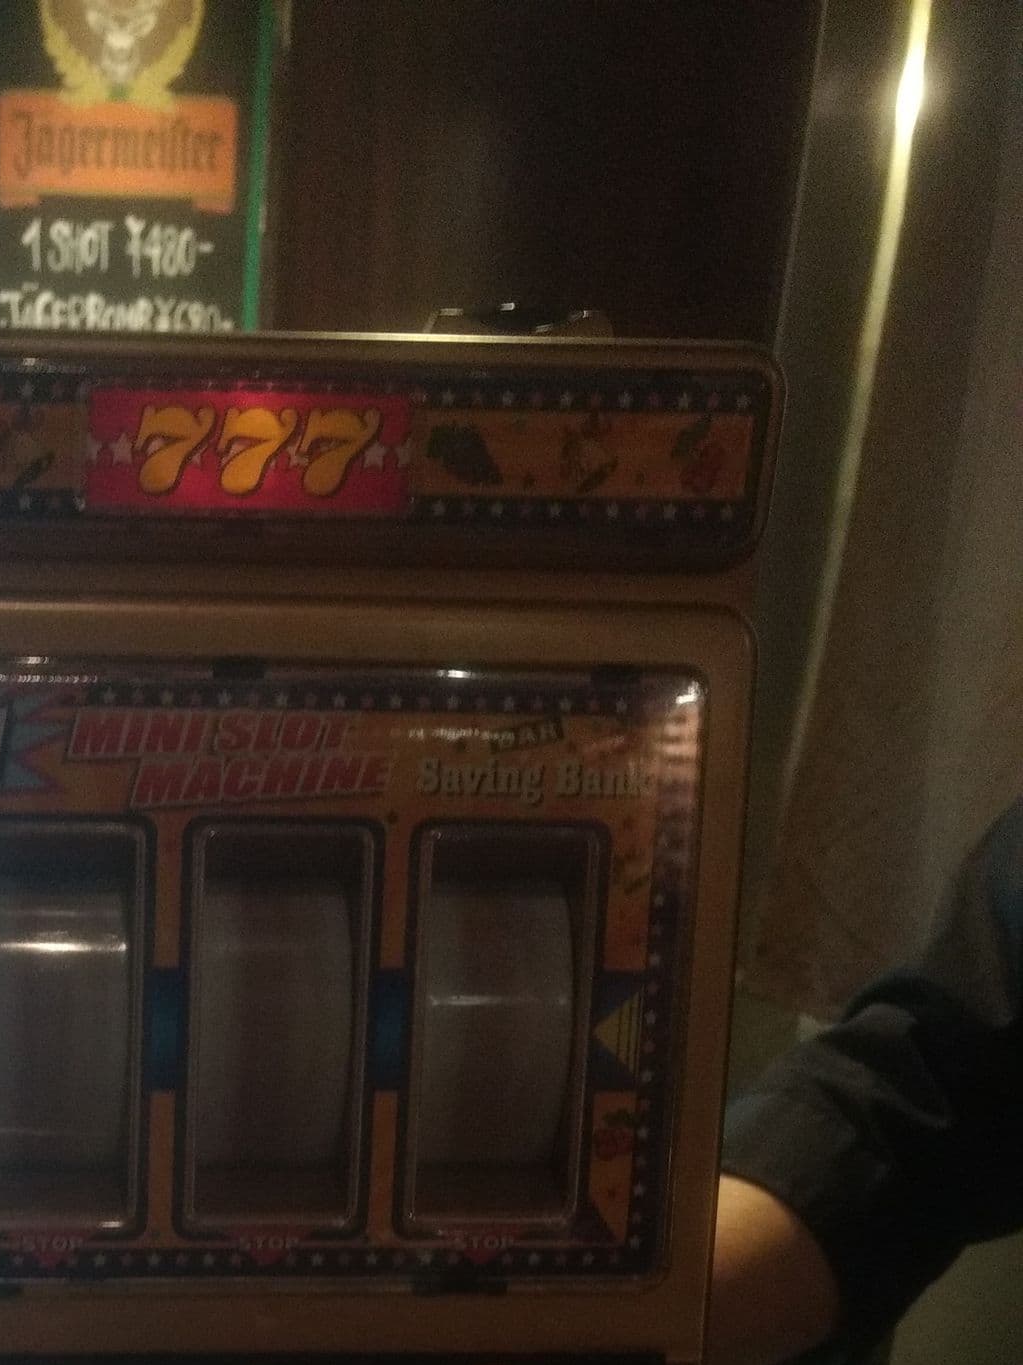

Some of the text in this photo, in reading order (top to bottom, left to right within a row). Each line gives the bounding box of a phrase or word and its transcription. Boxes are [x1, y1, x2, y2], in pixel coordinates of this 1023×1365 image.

[21, 217, 42, 272] 1
[47, 219, 114, 274] SHOT
[69, 711, 352, 754] MINI SLOT
[131, 754, 389, 806] MACHINE
[417, 757, 652, 806] Saving Bank
